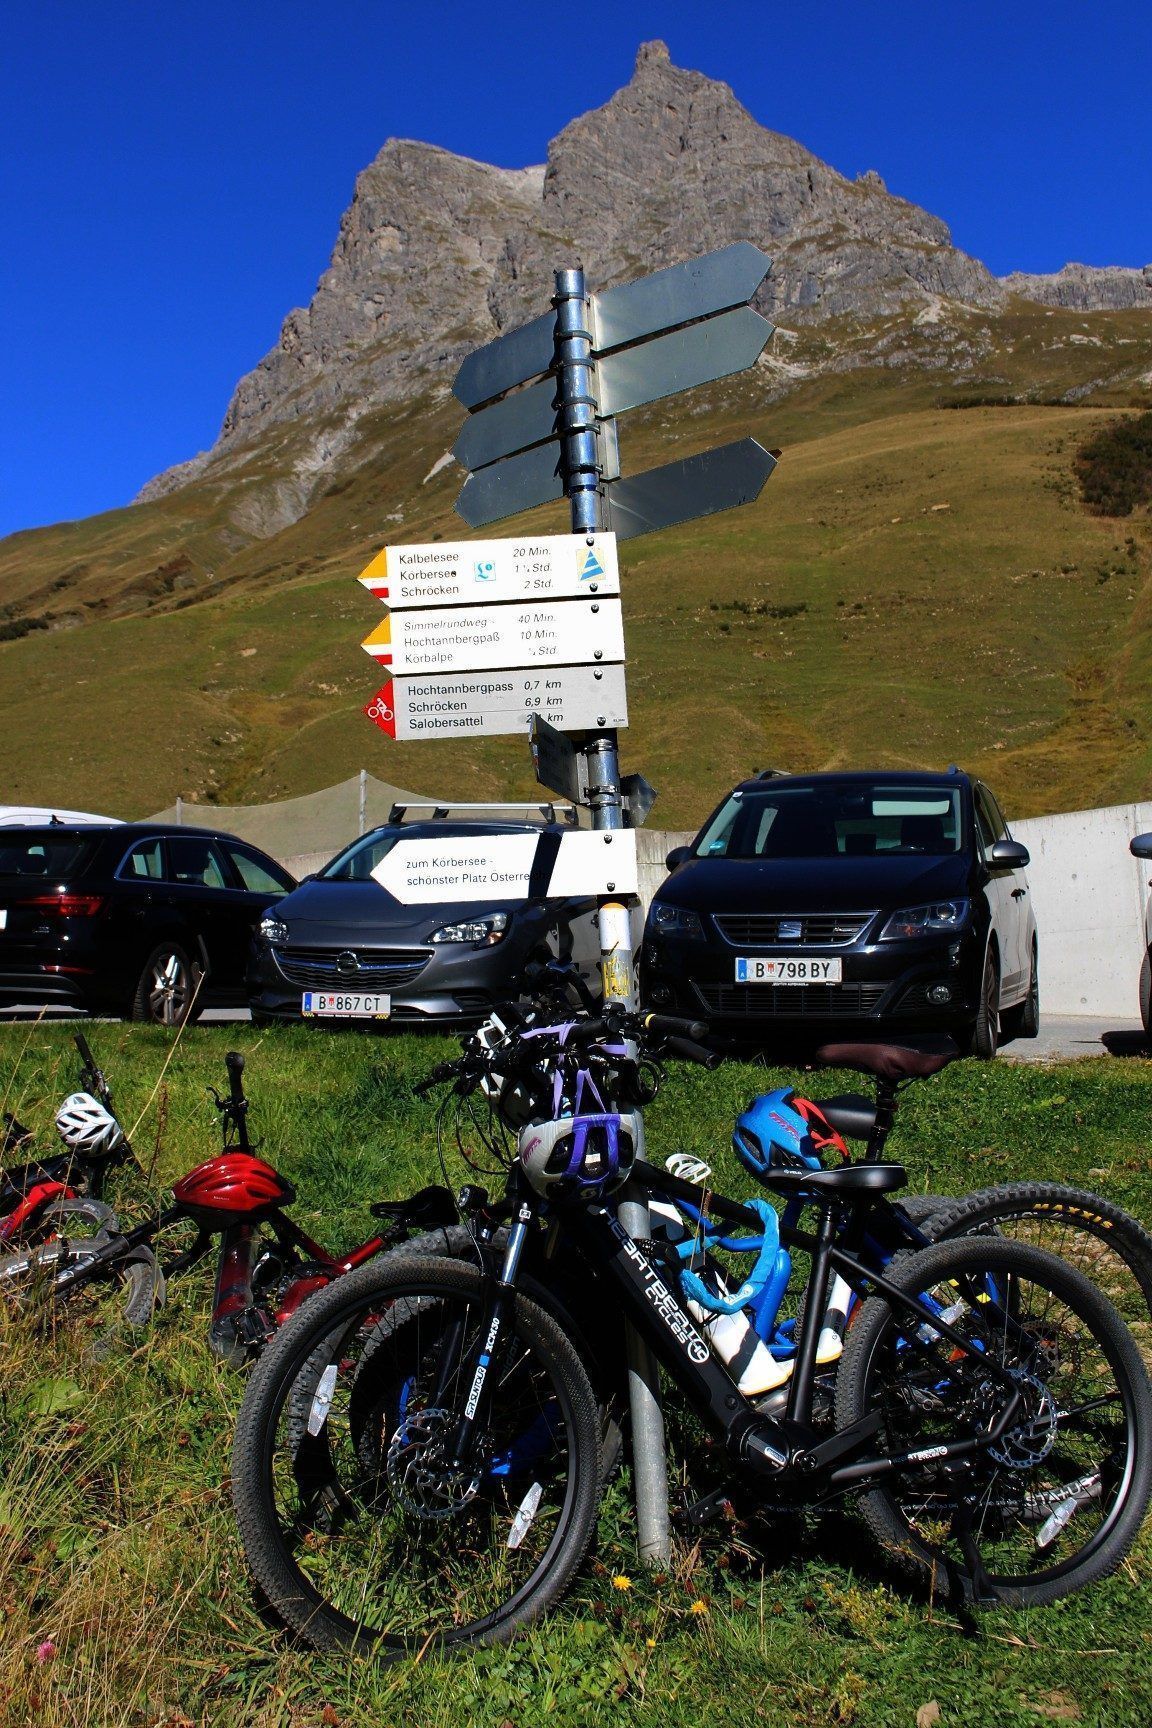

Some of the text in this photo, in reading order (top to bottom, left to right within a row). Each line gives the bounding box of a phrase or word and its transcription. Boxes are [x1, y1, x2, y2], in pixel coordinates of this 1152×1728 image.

[399, 547, 552, 565] Kalbelesee 20 Min.
[532, 563, 553, 573] Std.
[401, 579, 554, 597] Schröcken 2 Std.
[404, 612, 557, 632] Simmelrundweg 40 Min.
[404, 629, 558, 649] Hochtannbergpaß 10 Min.
[407, 679, 562, 698] Hochtannbergpass 0,7 km
[408, 696, 563, 714] Schröcken 6,9 km
[409, 715, 484, 730] Salobersattel
[547, 712, 564, 722] km
[405, 859, 429, 869] zum
[432, 855, 487, 868] Körbersee
[407, 869, 550, 886] schönster Platz Österre
[756, 962, 765, 978] B
[777, 962, 807, 978] 798
[811, 962, 830, 978] BY
[319, 996, 326, 1009] B
[336, 996, 360, 1010] 867
[364, 997, 381, 1011] CT
[485, 1317, 500, 1353] XCM30
